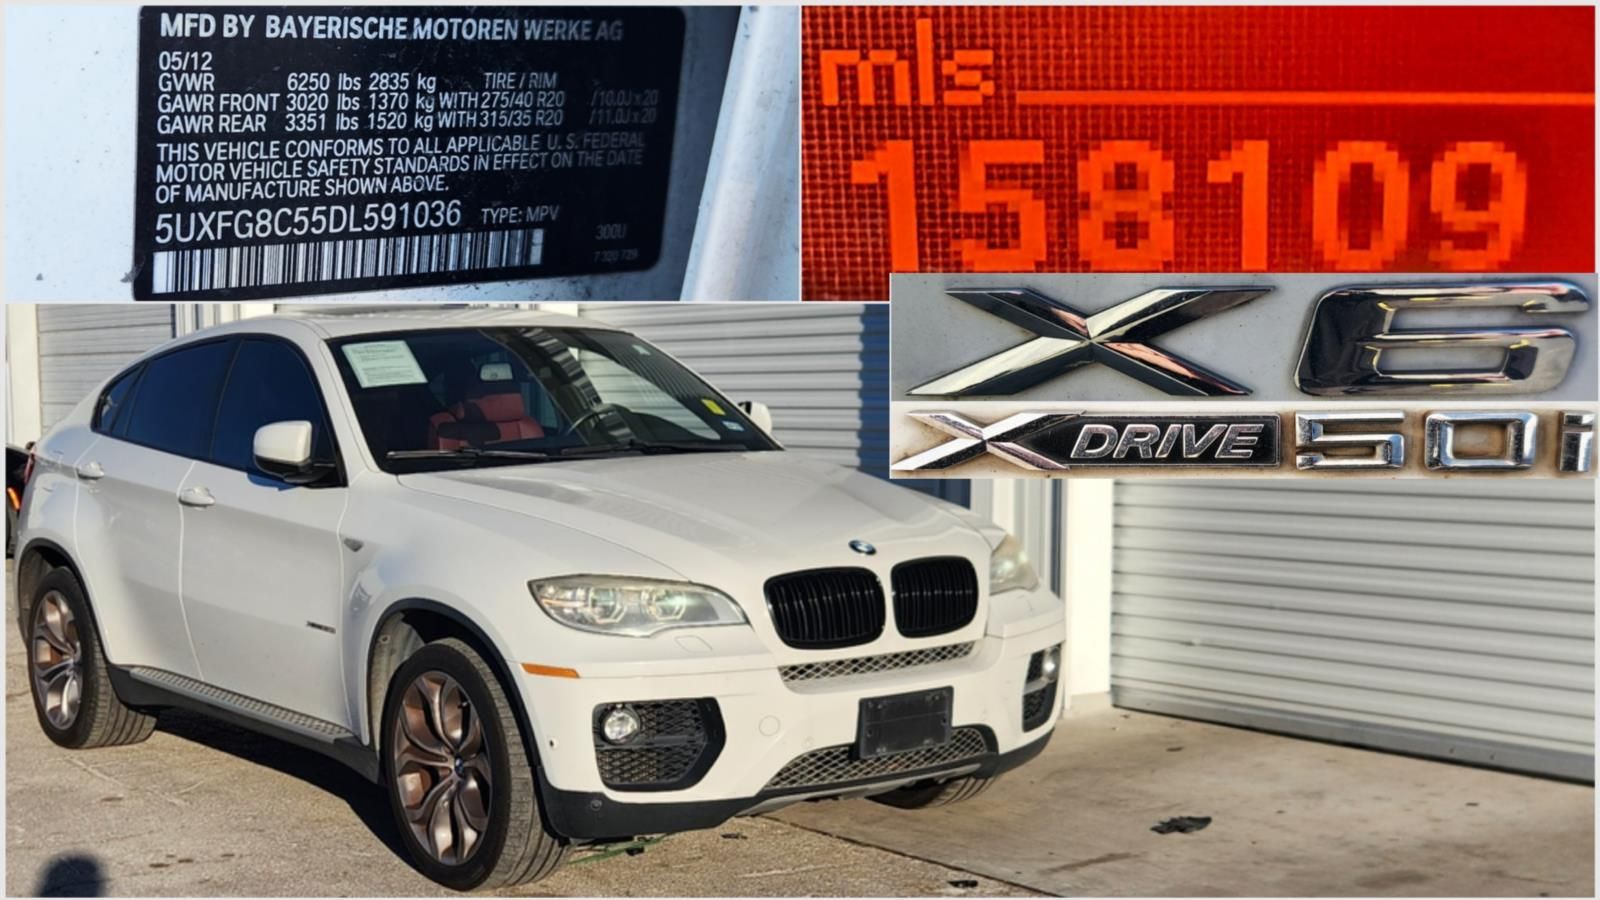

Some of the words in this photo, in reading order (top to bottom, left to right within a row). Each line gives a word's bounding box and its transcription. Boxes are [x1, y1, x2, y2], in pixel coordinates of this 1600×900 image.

[160, 13, 216, 38] MFD
[223, 14, 255, 38] BY
[266, 15, 408, 39] BAYERISCHE
[413, 18, 518, 40] MOTOREN
[524, 19, 592, 40] WERKE
[596, 20, 623, 40] AG
[158, 51, 213, 71] 05/12
[821, 18, 994, 105] mls
[158, 73, 215, 92] GVWR
[287, 73, 330, 91] 6250
[338, 74, 361, 91] lbs
[369, 73, 409, 91] 2835
[417, 73, 437, 93] kg
[484, 72, 516, 89] TIRE
[529, 72, 557, 89] RIM
[157, 94, 214, 113] GAWR
[220, 94, 280, 112] FRONT
[286, 93, 328, 111] 3020
[337, 94, 360, 111] lbs
[369, 93, 409, 110] 1370
[416, 92, 435, 113] kg
[438, 92, 479, 109] WITH
[481, 91, 533, 109] 275/40
[536, 90, 565, 108] R20
[157, 115, 214, 134] GAWR
[218, 114, 266, 133] REAR
[285, 113, 325, 132] 3351
[336, 113, 359, 131] lbs
[368, 112, 407, 130] 1520
[414, 112, 433, 132] kg
[437, 111, 477, 129] WITH
[479, 110, 531, 128] 315/35
[535, 109, 563, 126] R20
[156, 143, 199, 162] THIS
[204, 141, 280, 161] VEHICLE
[285, 138, 383, 159] CONFORMS
[388, 138, 409, 154] TO
[413, 137, 442, 154] ALL
[446, 134, 540, 153] APPLICABLE
[583, 132, 645, 149] FEDERAL
[156, 163, 224, 183] MOTOR
[229, 160, 302, 180] VEHICLE
[307, 158, 369, 177] SAFETY
[374, 155, 469, 175] STANDARDS
[474, 154, 489, 171] IN
[494, 152, 548, 170] EFFECT
[551, 151, 572, 168] ON
[577, 150, 602, 167] THE
[606, 149, 643, 165] DATE
[156, 185, 180, 204] OF
[185, 179, 320, 202] MANUFACTURE
[325, 177, 387, 197] SHOWN
[391, 174, 449, 194] ABOVE.
[851, 139, 1527, 271] 158109
[155, 200, 461, 244] 5UXFG8C55DL591036
[481, 207, 522, 225] TYPE:
[526, 205, 560, 223] MPV
[1295, 409, 1594, 472] 50i
